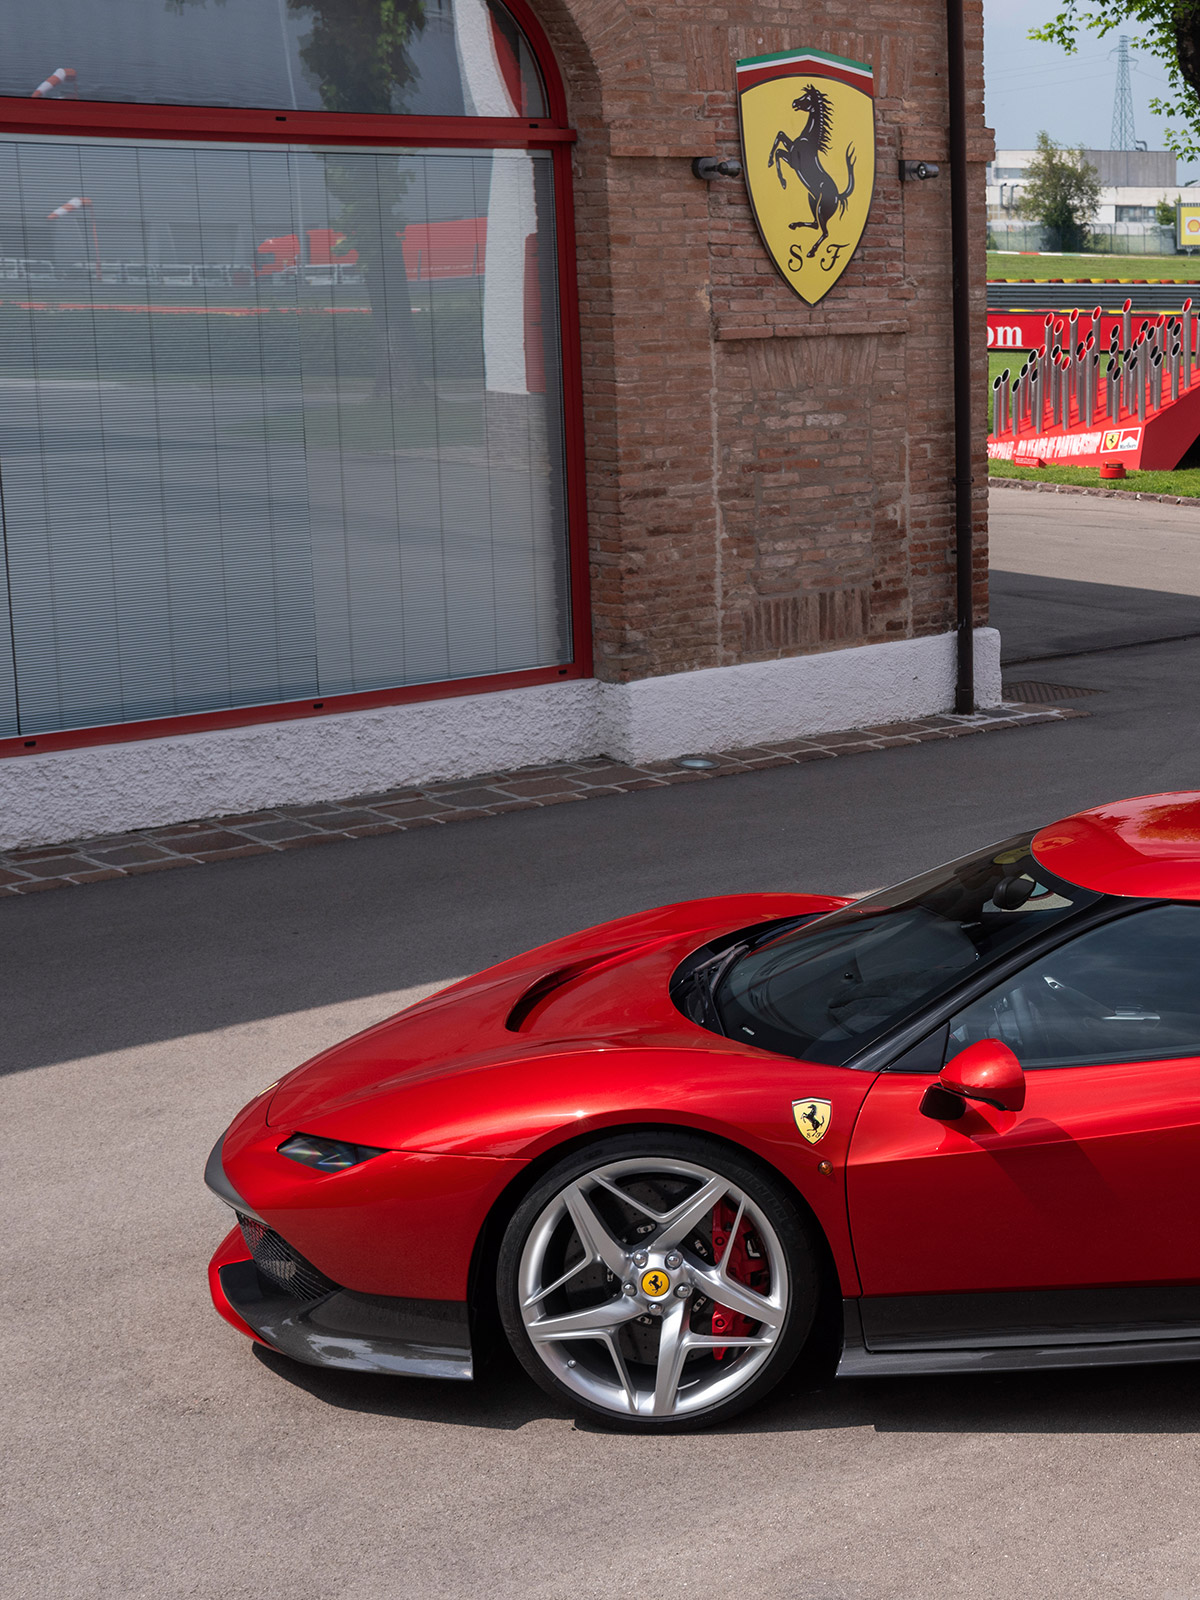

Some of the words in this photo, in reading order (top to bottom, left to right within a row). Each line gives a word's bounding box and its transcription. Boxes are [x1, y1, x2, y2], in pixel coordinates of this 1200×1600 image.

[787, 244, 803, 272] S
[819, 243, 850, 271] F
[1053, 431, 1102, 458] PARTNERSHIP
